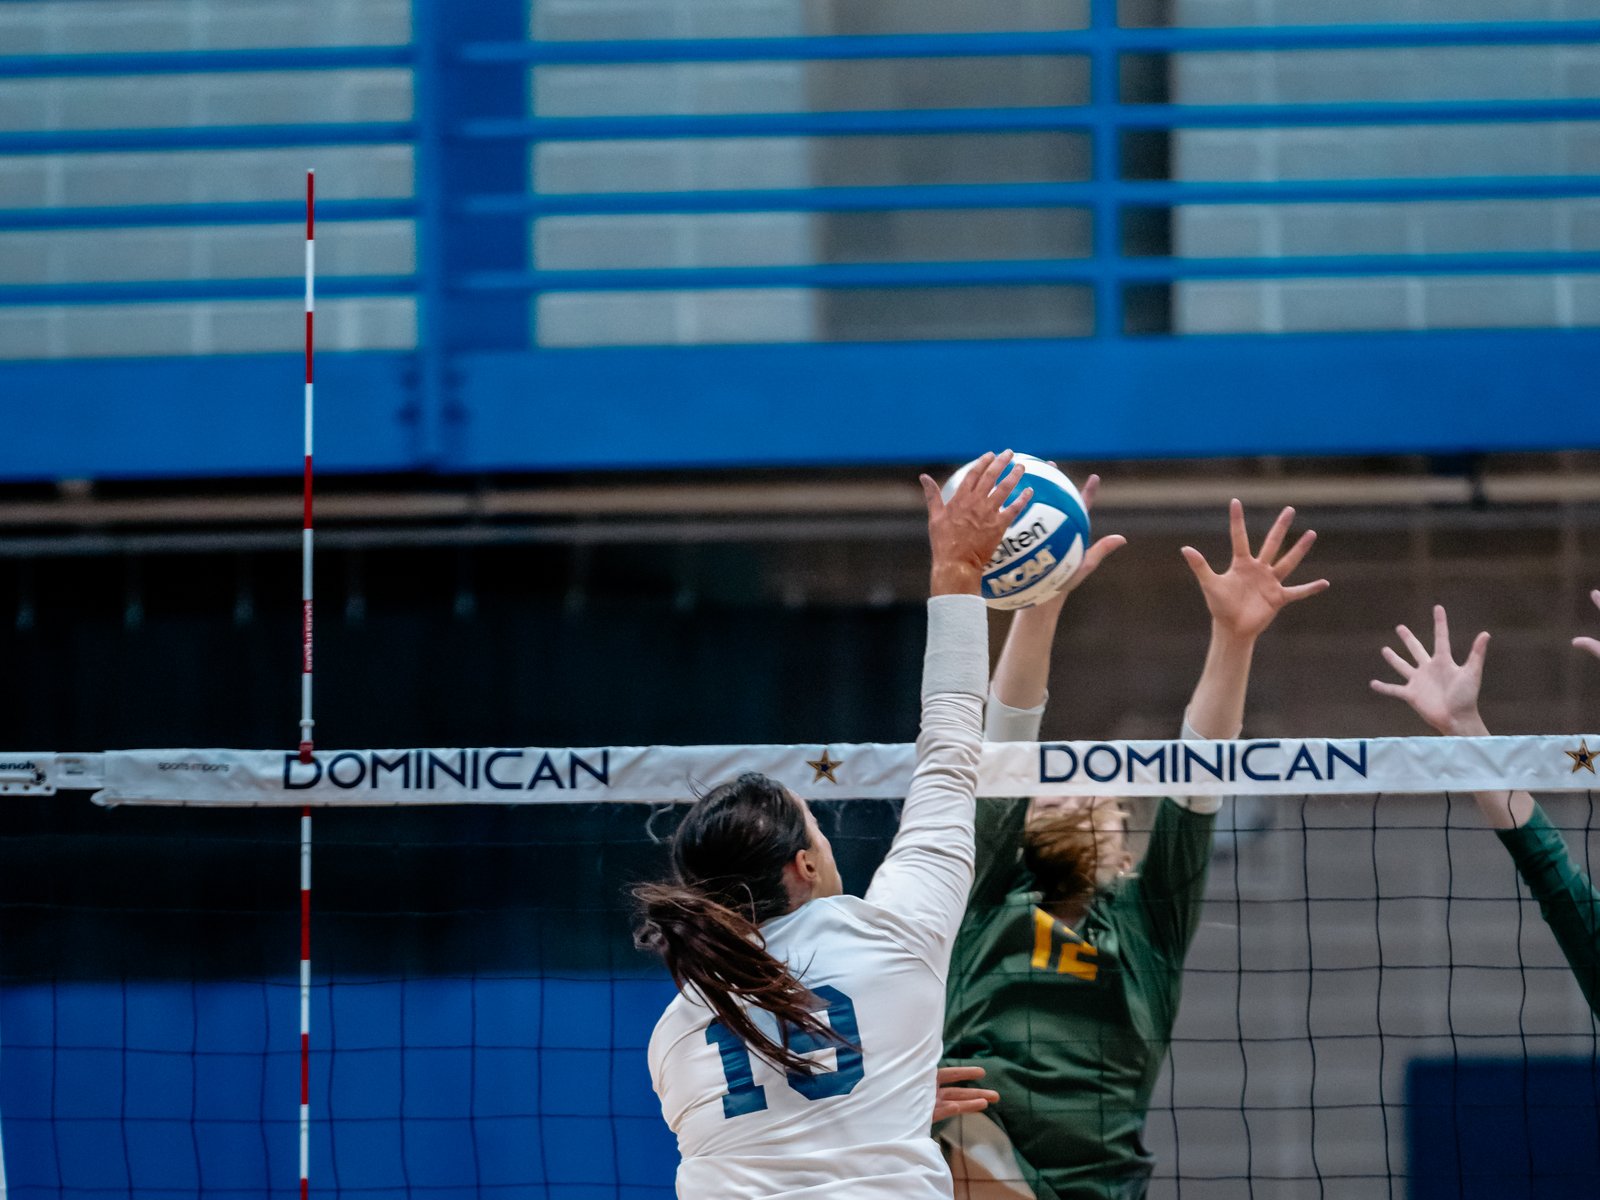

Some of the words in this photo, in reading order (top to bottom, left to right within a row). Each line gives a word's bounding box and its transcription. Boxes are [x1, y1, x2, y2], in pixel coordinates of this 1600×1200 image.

[987, 548, 1057, 597] NCAA
[283, 750, 610, 791] DOMINICAN
[1039, 740, 1368, 783] DOMINICAN
[704, 984, 865, 1120] 19
